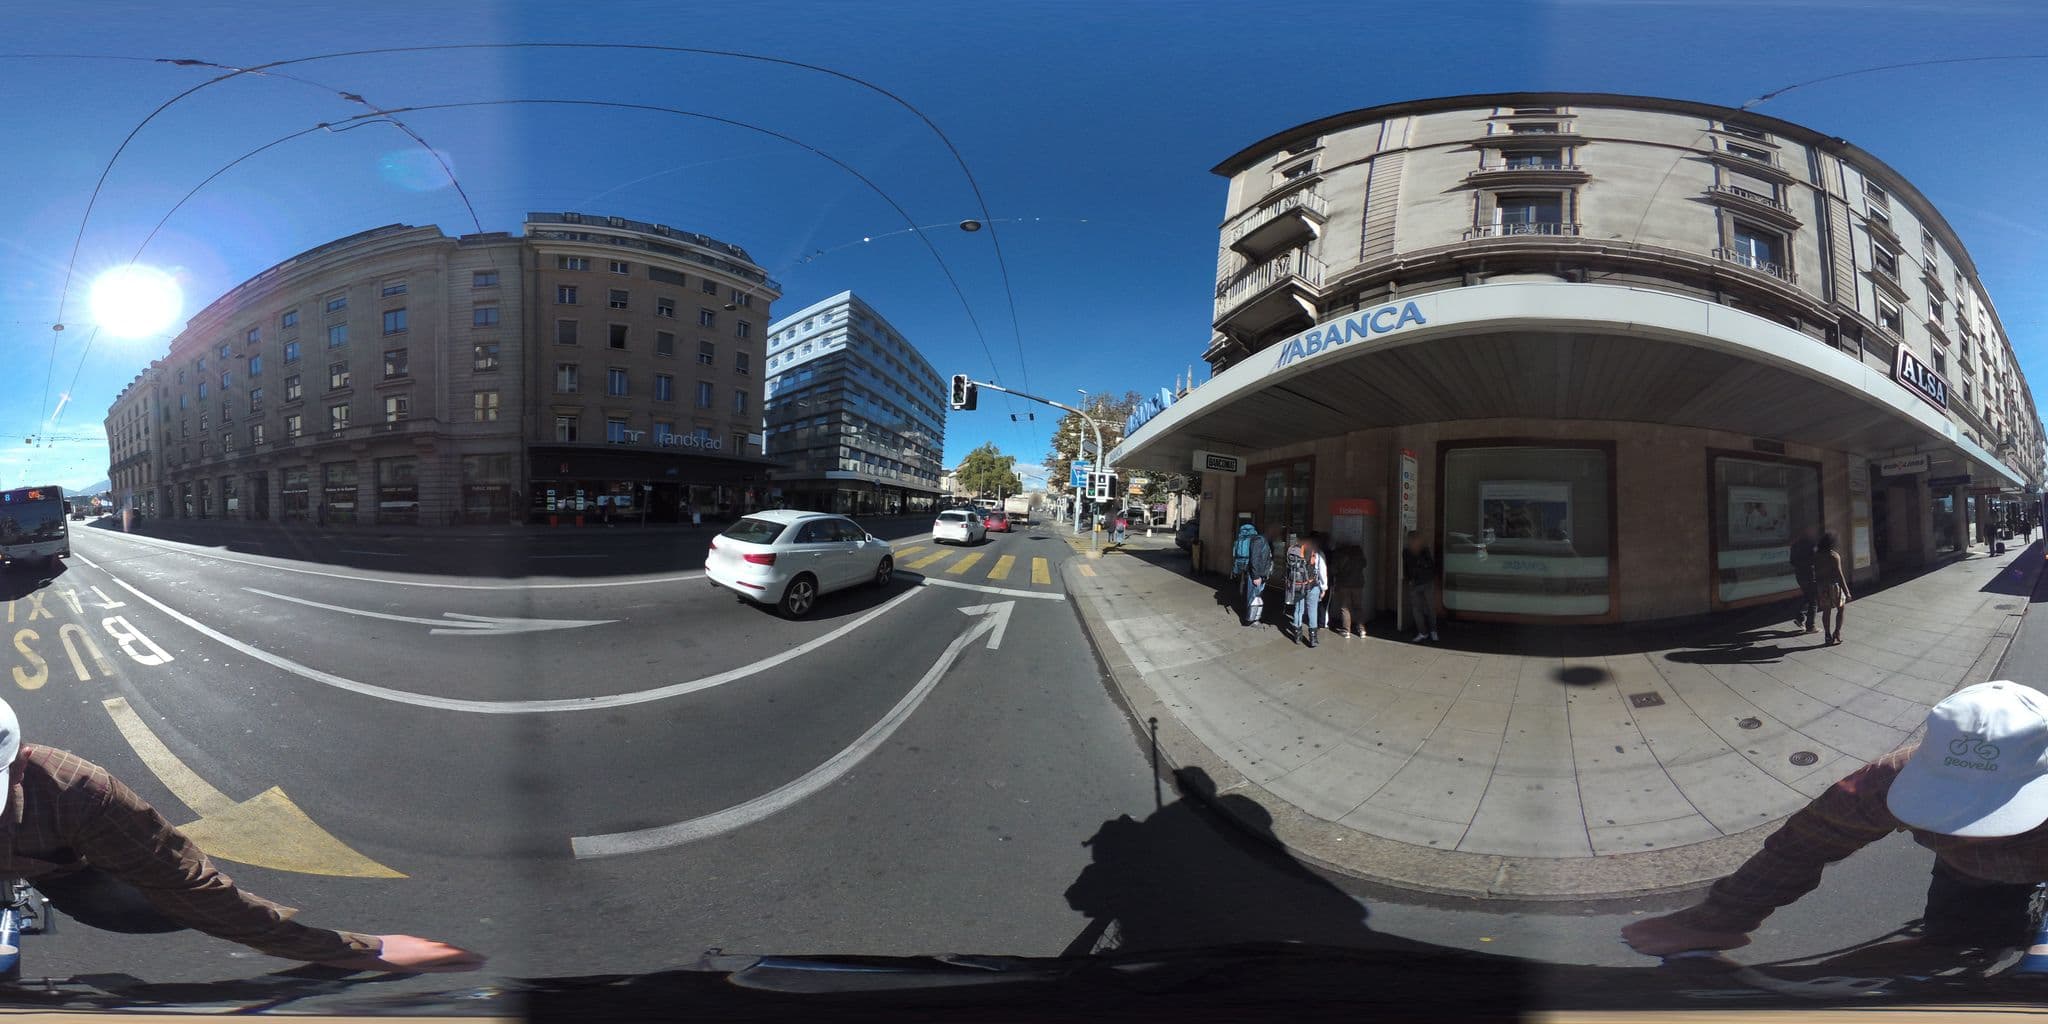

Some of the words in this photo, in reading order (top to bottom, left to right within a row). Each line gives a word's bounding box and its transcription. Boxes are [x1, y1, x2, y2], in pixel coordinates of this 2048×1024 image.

[1277, 300, 1427, 368] ABANCA
[1902, 354, 1946, 405] ALSA
[658, 431, 723, 451] randstad
[4, 493, 12, 502] 8
[7, 585, 127, 624] TAXI
[12, 615, 175, 690] BUS
[1944, 757, 1998, 771] geovelo
